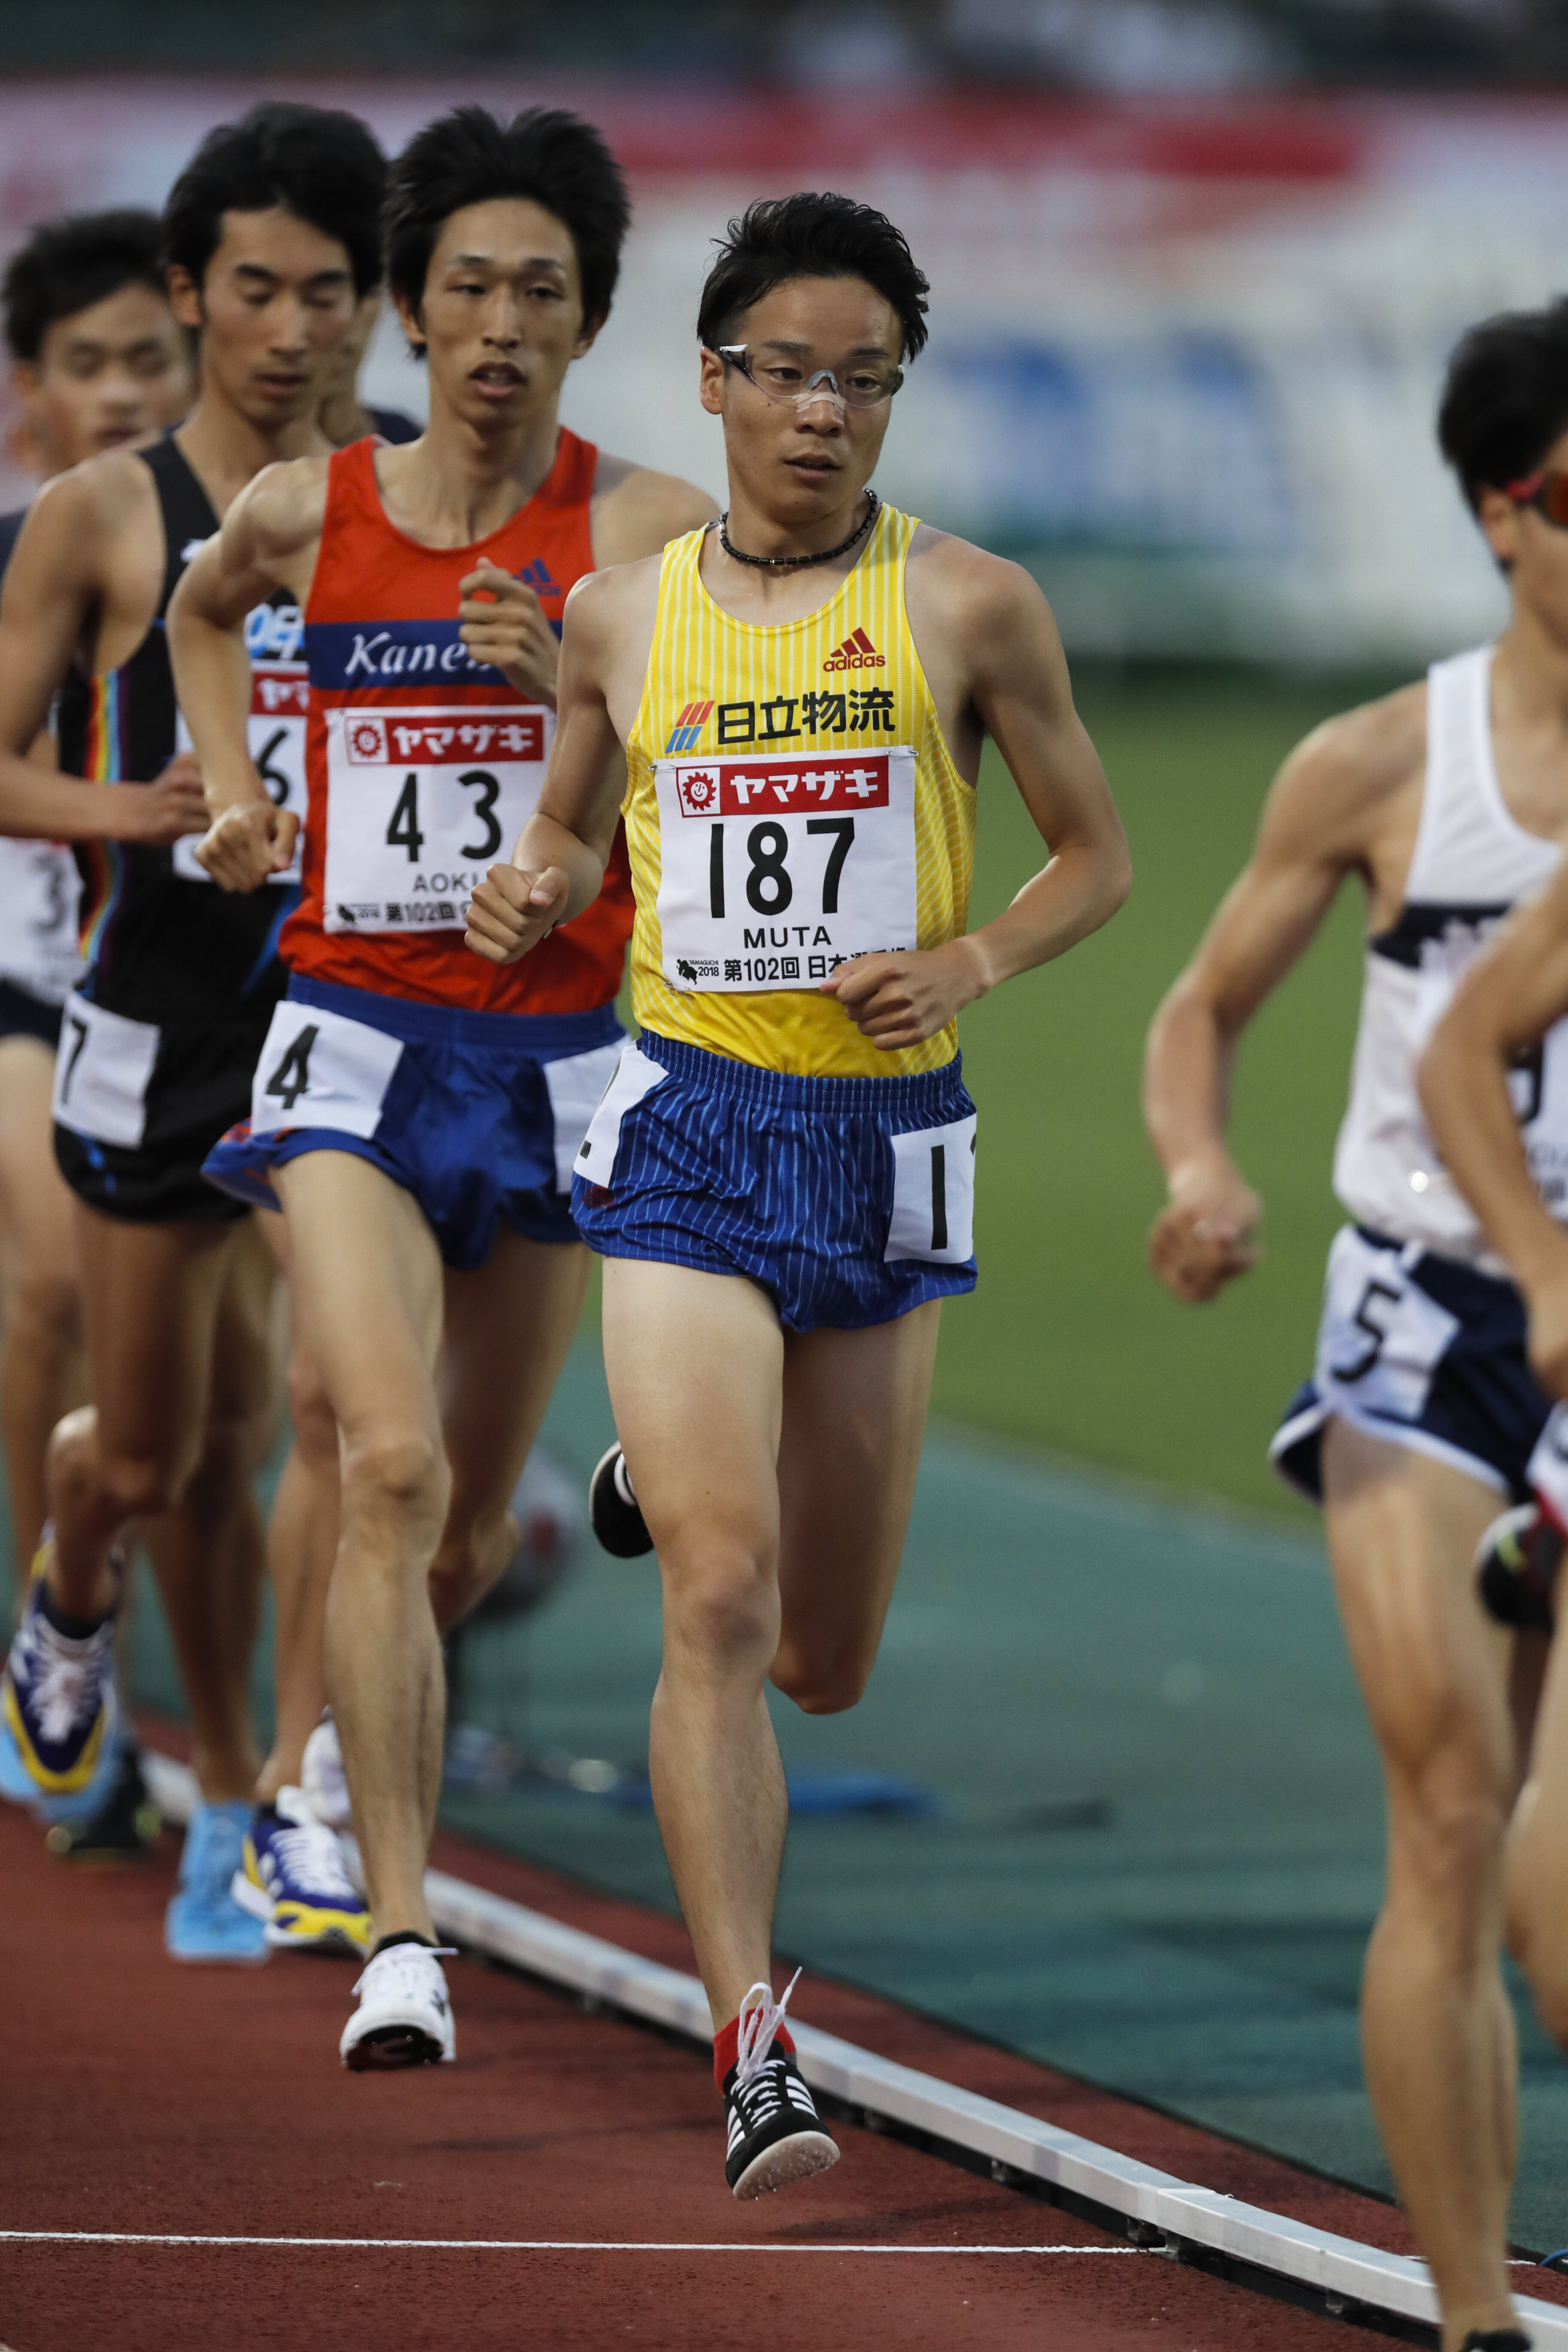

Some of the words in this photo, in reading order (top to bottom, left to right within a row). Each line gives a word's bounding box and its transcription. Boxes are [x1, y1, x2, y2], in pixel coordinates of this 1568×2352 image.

[823, 653, 886, 672] adidas
[717, 687, 895, 745] 日立物流
[393, 726, 534, 755] ヤマザキ
[730, 769, 879, 804] ヤマザキ
[387, 770, 502, 862] 43
[413, 873, 478, 893] AOKI
[710, 817, 855, 919] 187
[744, 926, 832, 949] MUTA
[698, 966, 720, 977] 2018
[724, 957, 799, 982] 第102回
[266, 1023, 319, 1109] 4
[1332, 1283, 1401, 1382] 5
